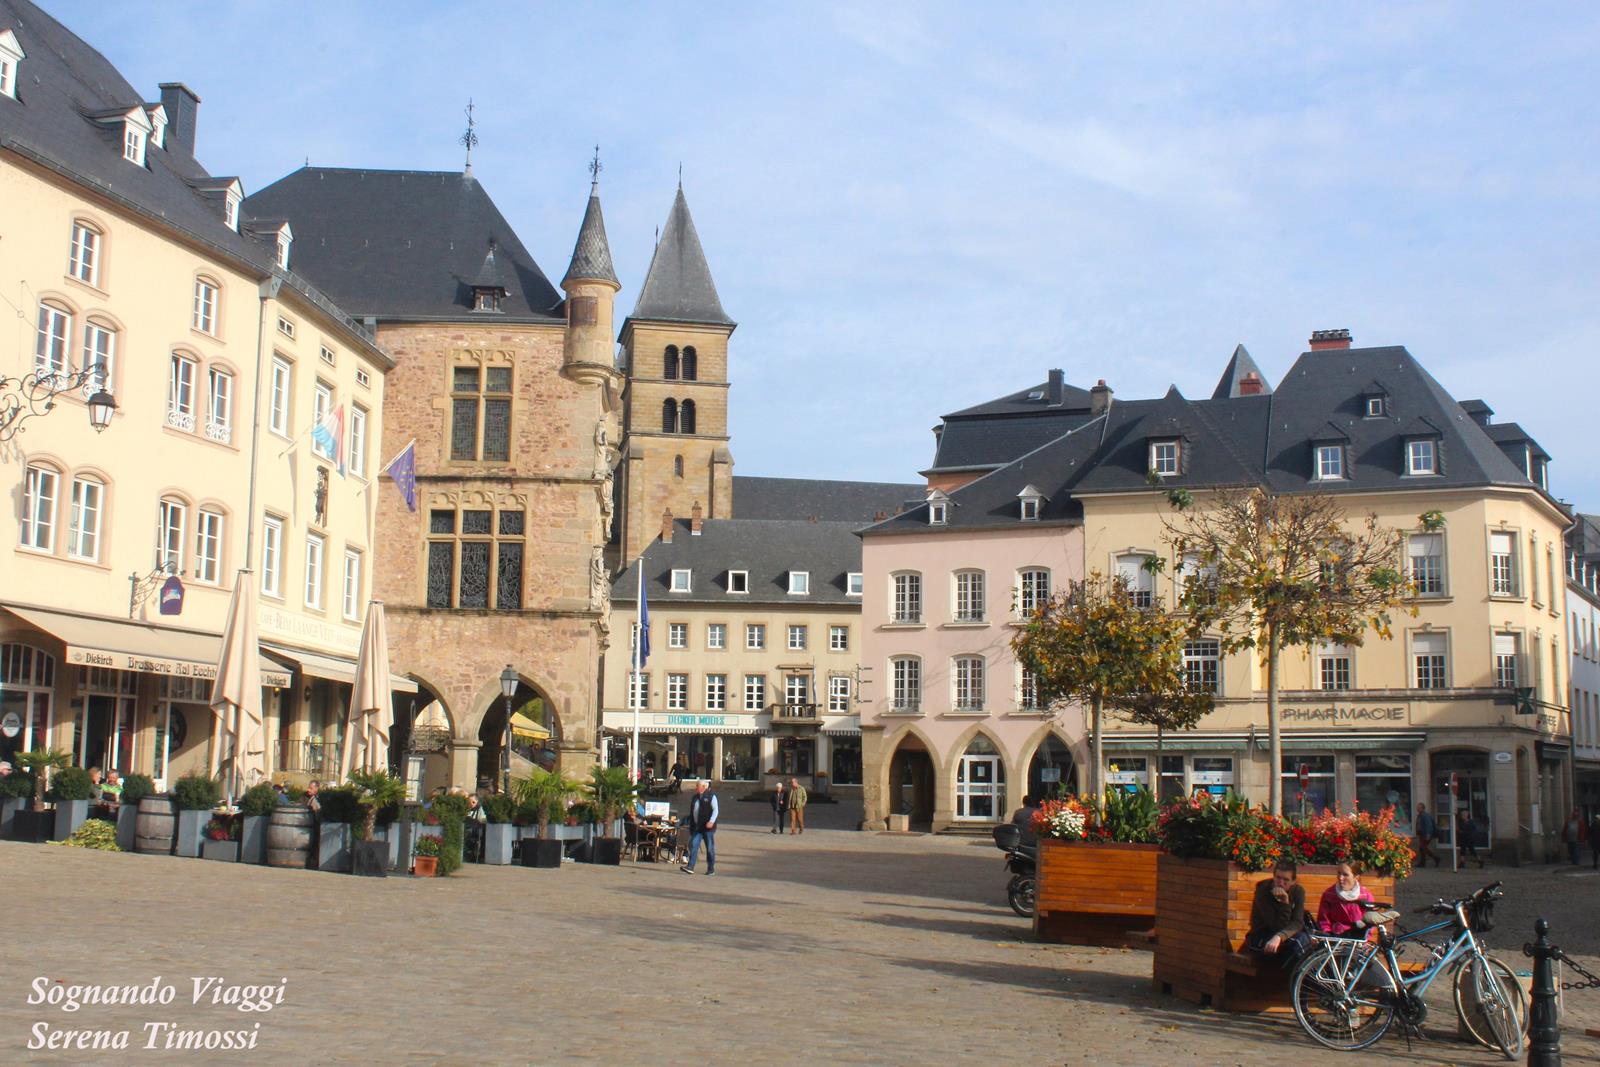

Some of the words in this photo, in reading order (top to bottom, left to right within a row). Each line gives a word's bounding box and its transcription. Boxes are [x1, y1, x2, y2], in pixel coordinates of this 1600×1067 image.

[85, 652, 114, 666] Diekirch
[128, 656, 172, 673] Brasserie
[668, 715, 696, 725] DECKER
[699, 715, 725, 726] MODES
[1281, 707, 1405, 721] PHARMACIE
